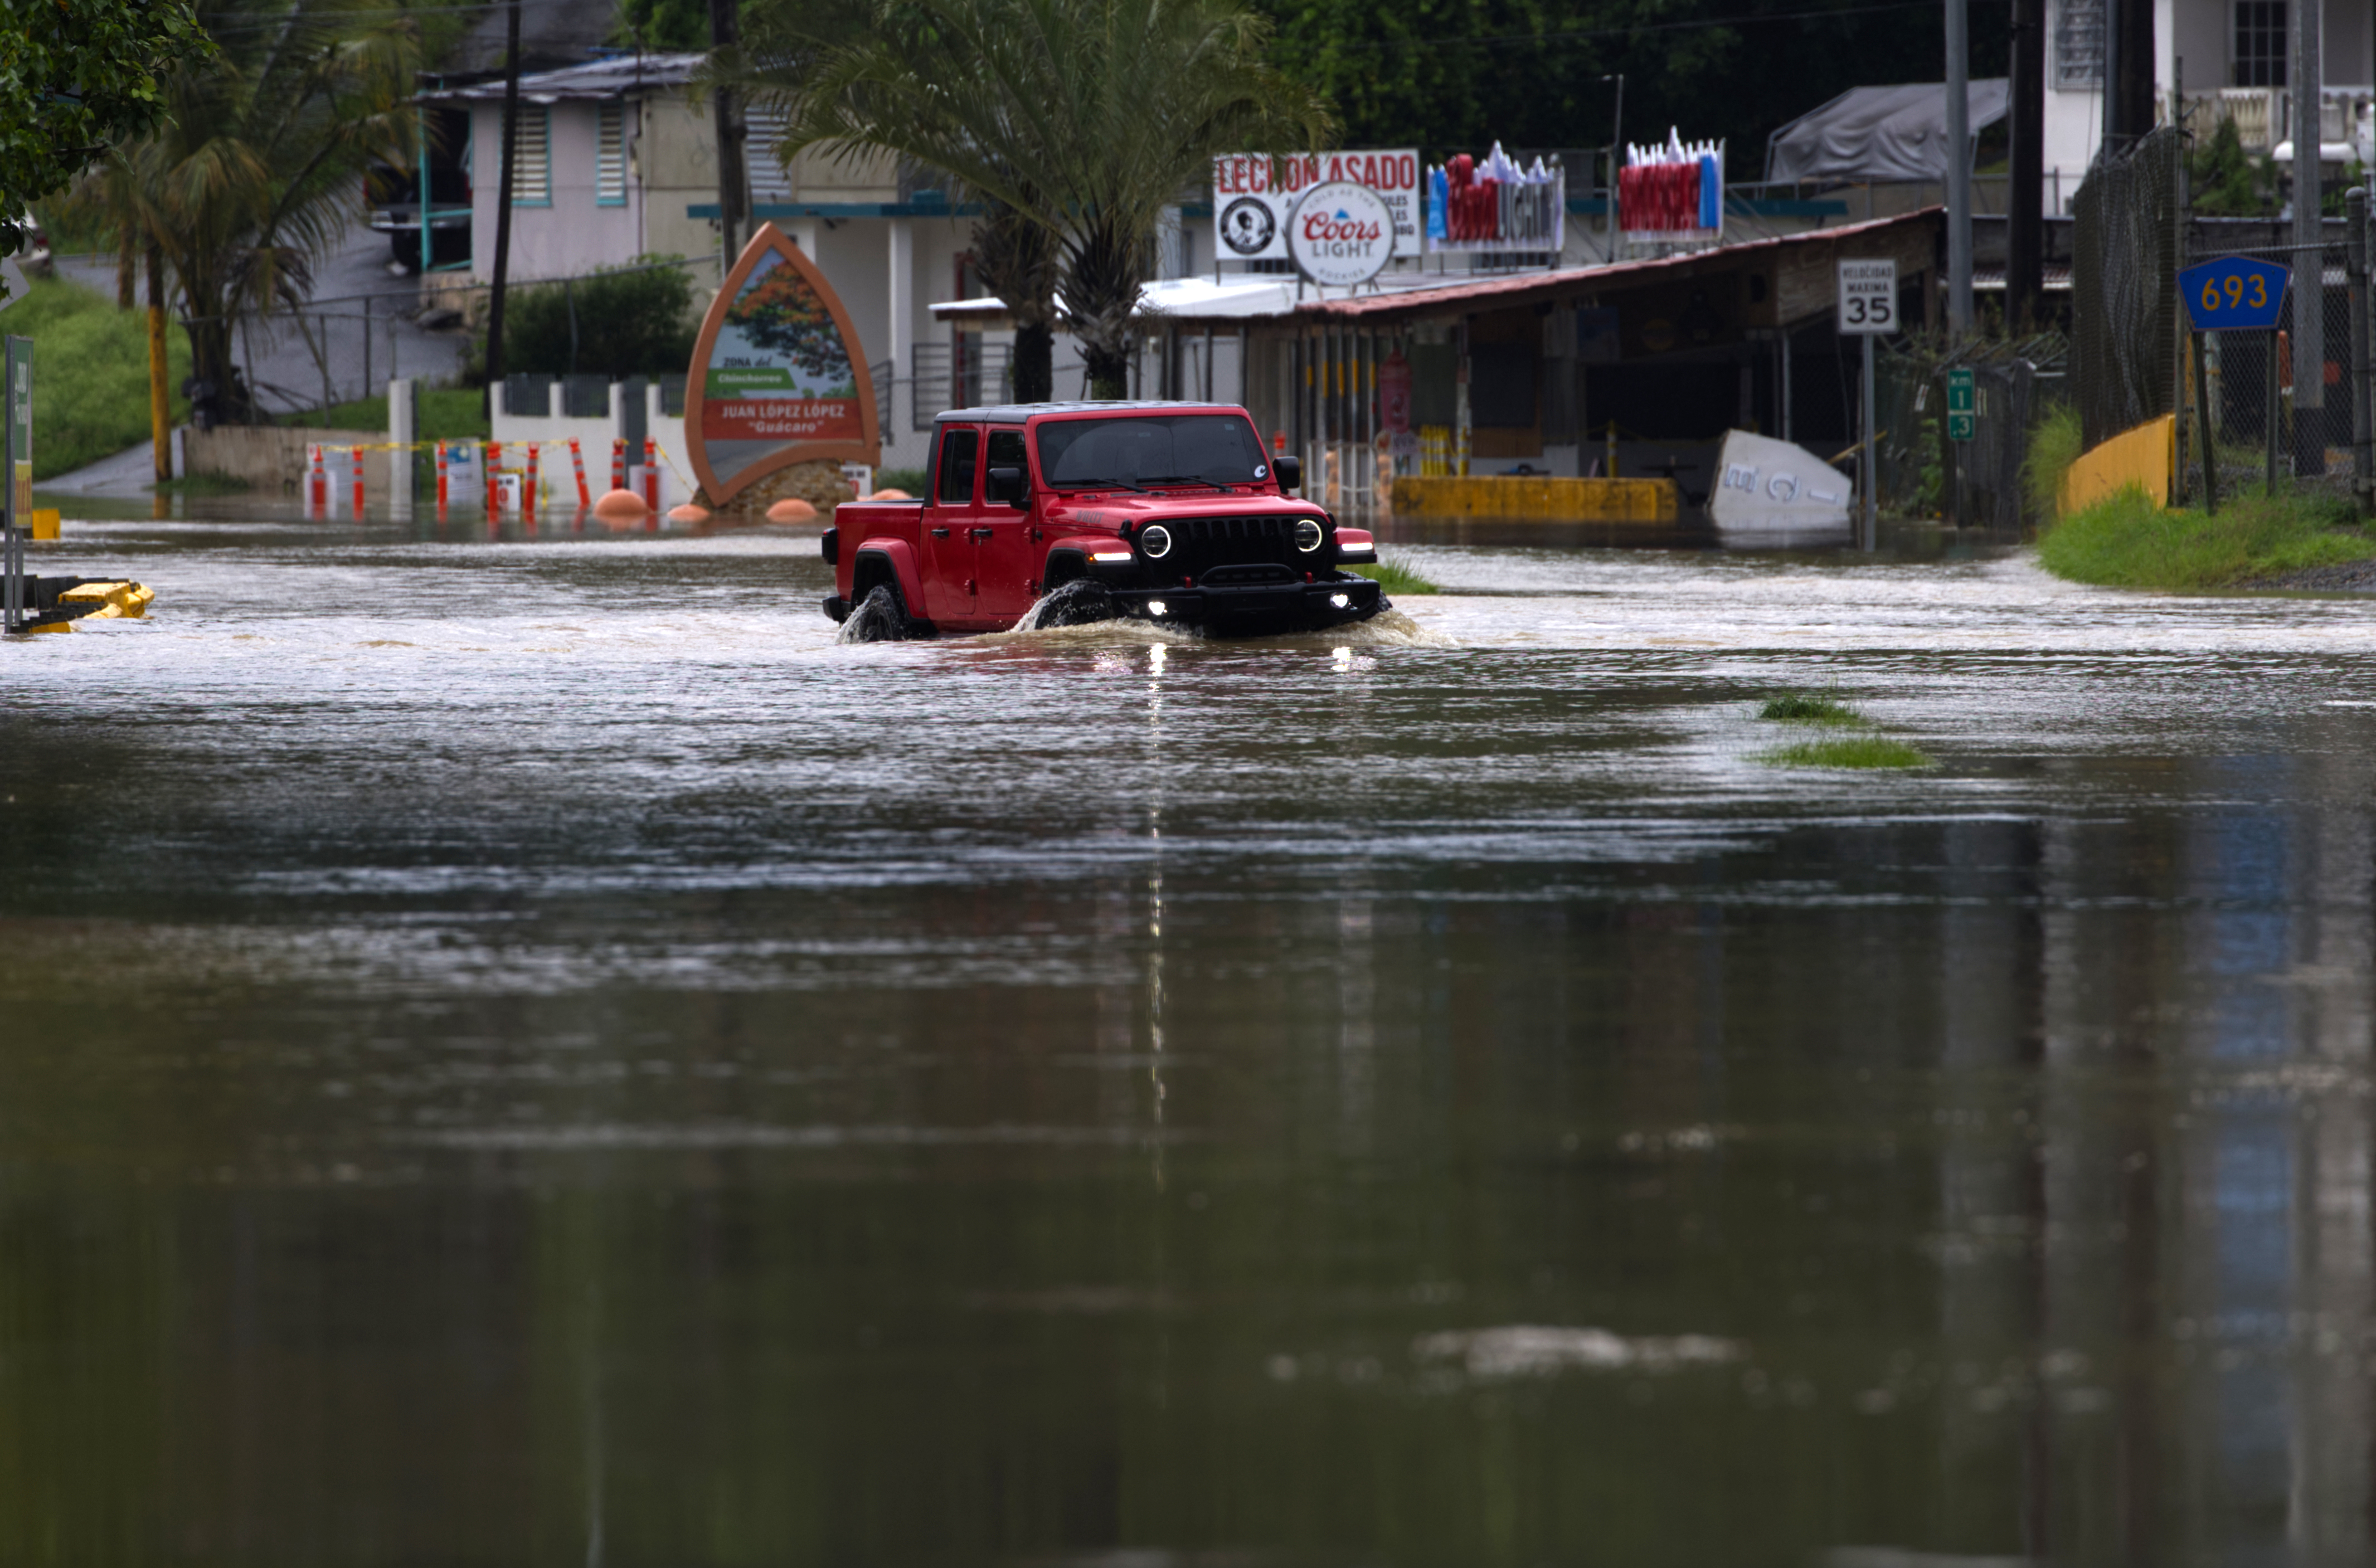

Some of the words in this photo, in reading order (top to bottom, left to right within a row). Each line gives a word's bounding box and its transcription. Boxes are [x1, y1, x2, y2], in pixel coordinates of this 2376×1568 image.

[1329, 153, 1416, 190] ASADO
[1303, 211, 1382, 241] Coors
[1312, 242, 1372, 258] LIGHT
[1843, 266, 1893, 278] VELOCIDAD
[2202, 274, 2267, 311] 693
[1847, 296, 1891, 324] 35
[724, 357, 752, 367] ZONA
[1950, 376, 1971, 386] km
[722, 406, 756, 417] JUAN
[760, 402, 800, 417] LÓPEZ
[804, 402, 845, 417] LÓPEZ
